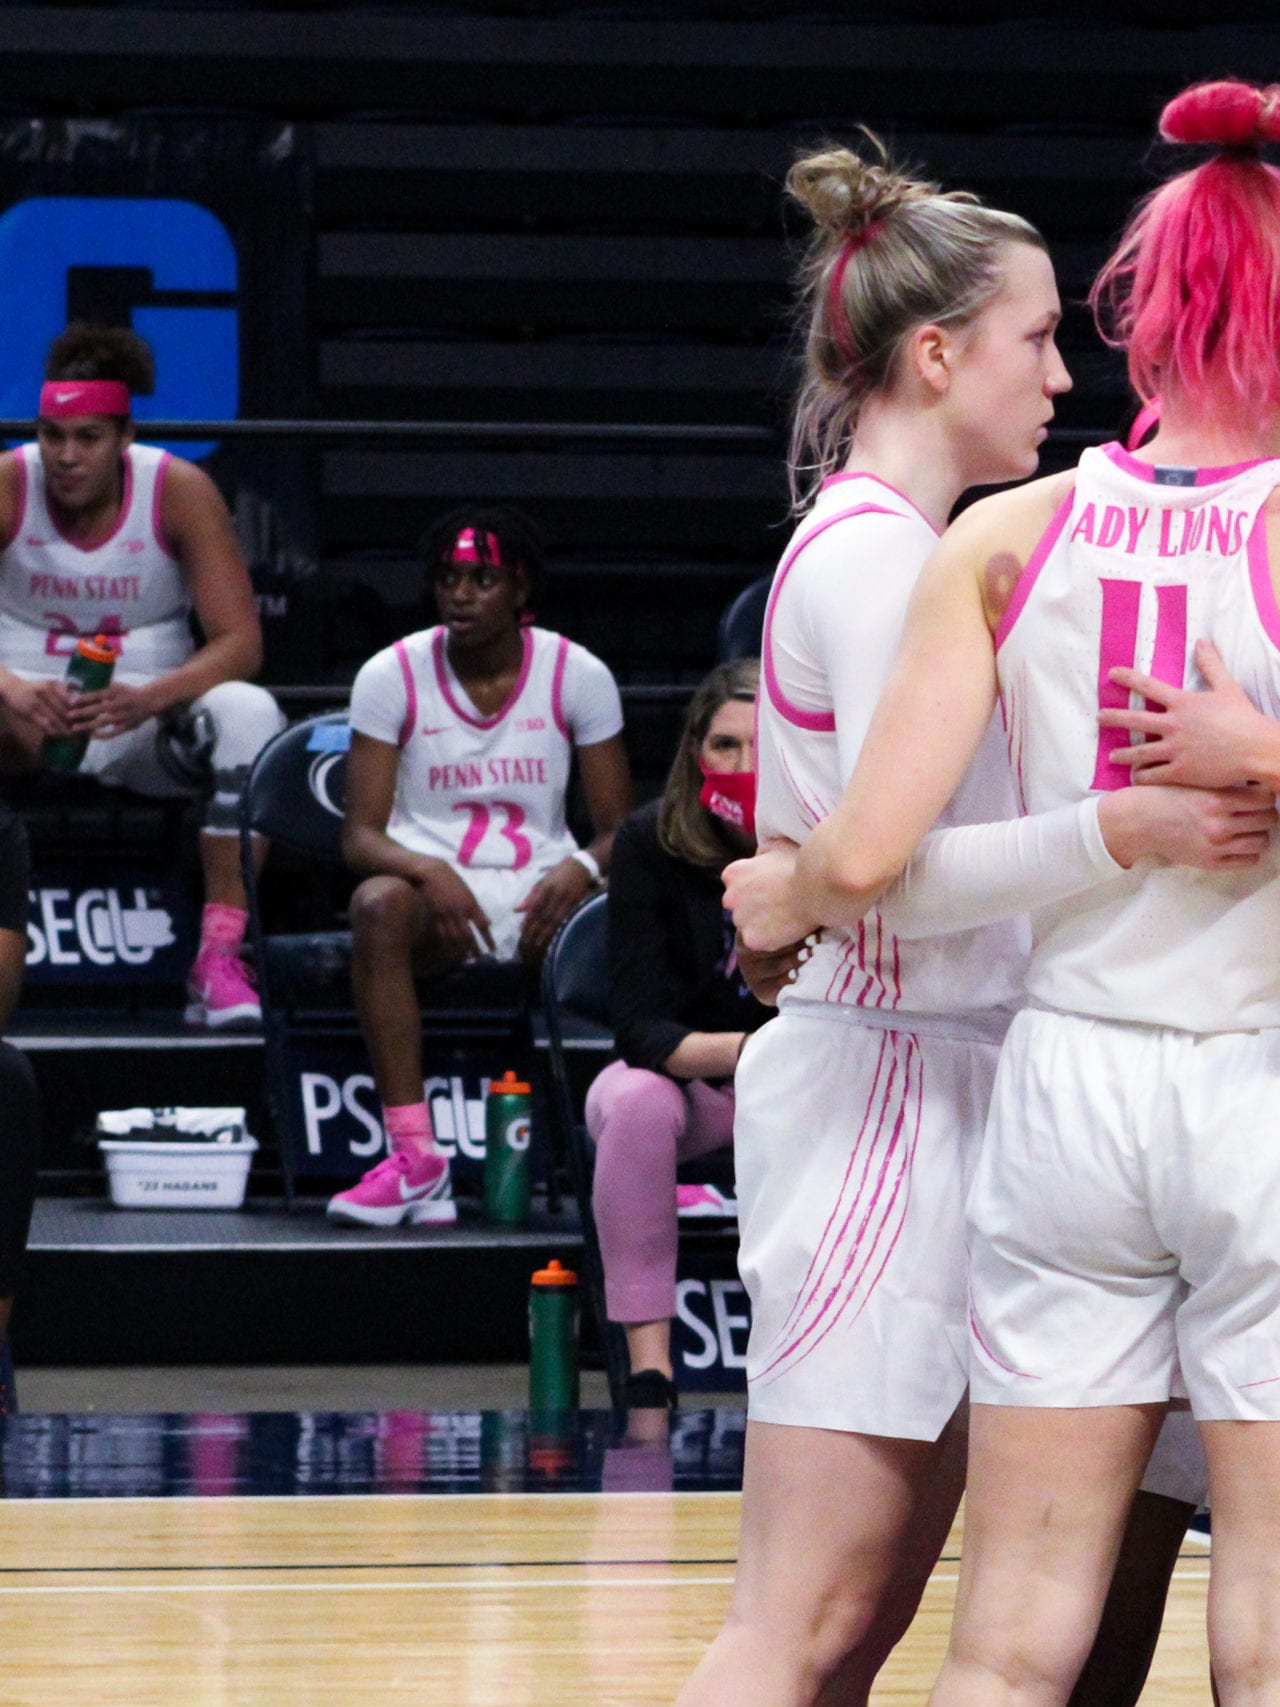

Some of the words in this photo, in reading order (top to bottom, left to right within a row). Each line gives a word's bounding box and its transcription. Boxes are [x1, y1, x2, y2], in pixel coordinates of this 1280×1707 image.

[30, 574, 78, 598] PENN
[86, 574, 139, 599] STATE
[1089, 577, 1187, 791] 11
[428, 763, 482, 791] PENN
[487, 757, 546, 785] STATE
[301, 1073, 490, 1159] PSCU
